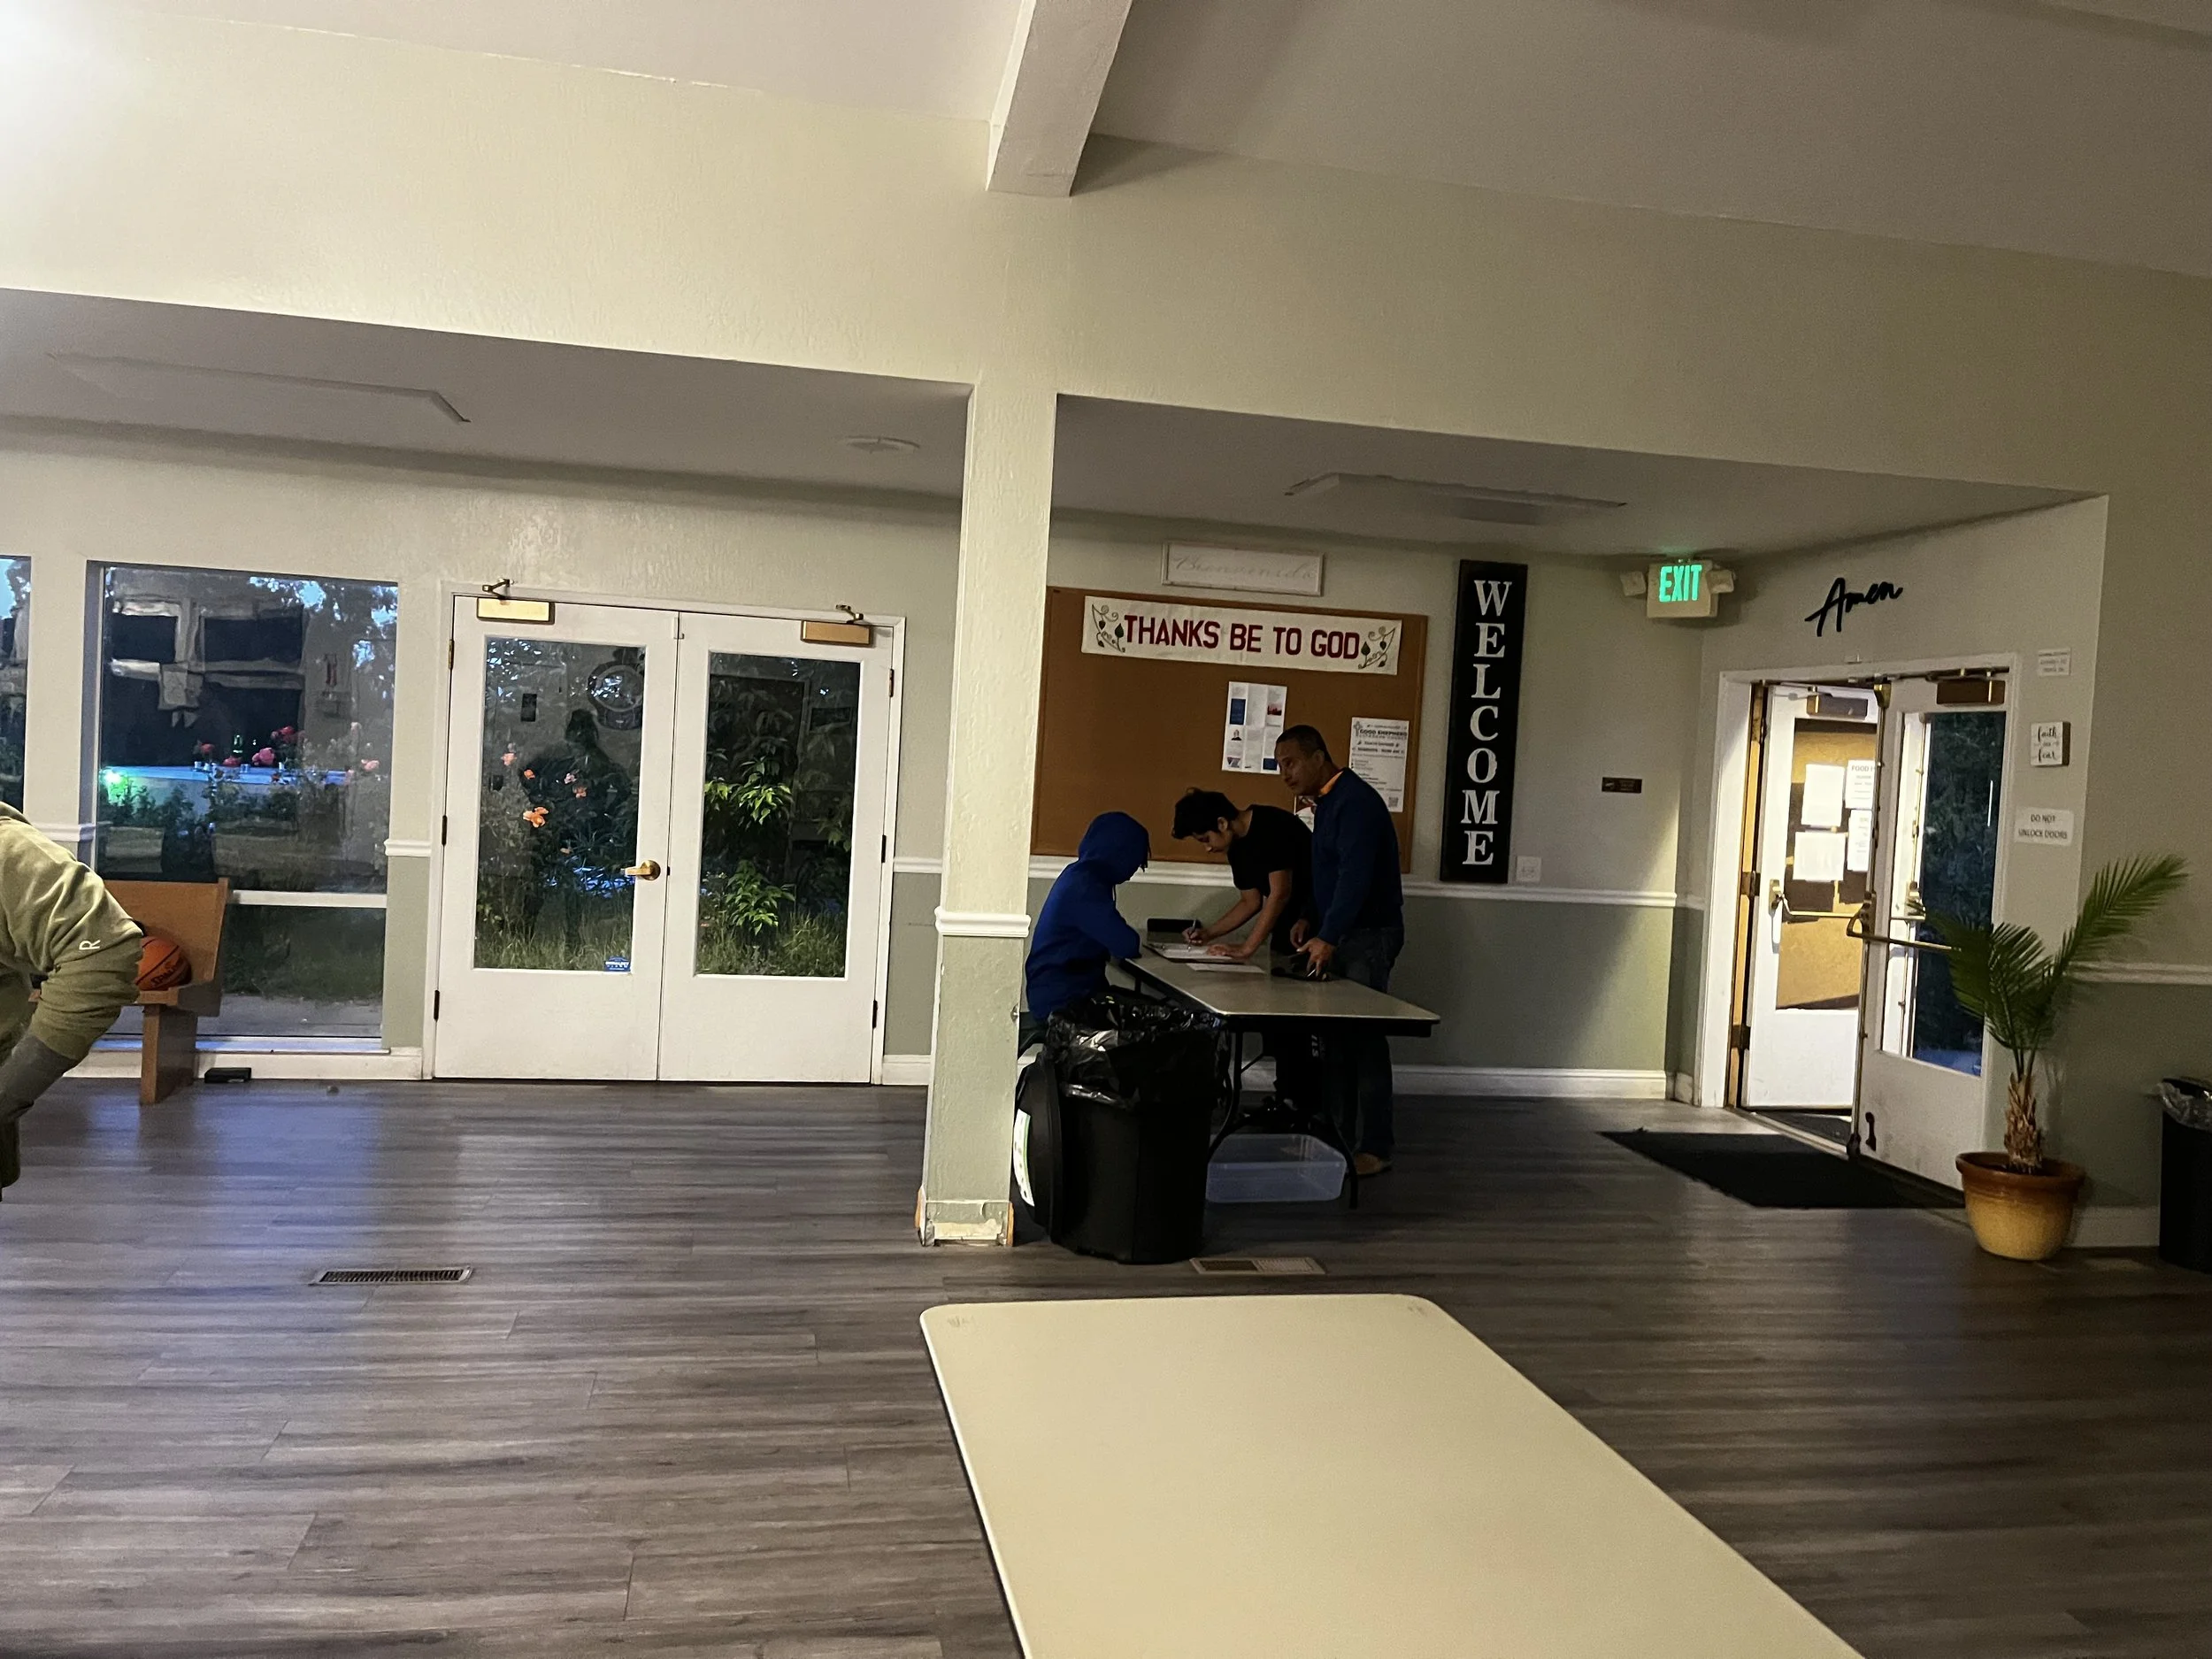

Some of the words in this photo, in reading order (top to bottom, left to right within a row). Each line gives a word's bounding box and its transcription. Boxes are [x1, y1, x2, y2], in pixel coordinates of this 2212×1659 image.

[1659, 565, 1702, 603] EXIT
[1804, 577, 1904, 637] Amen
[1124, 615, 1220, 649] THANKS
[1229, 623, 1263, 653] BE
[1273, 626, 1302, 656] TO
[1310, 629, 1361, 659] GOD
[1461, 580, 1512, 865] WELCOME
[2042, 814, 2056, 824] NOT
[79, 940, 101, 950] R
